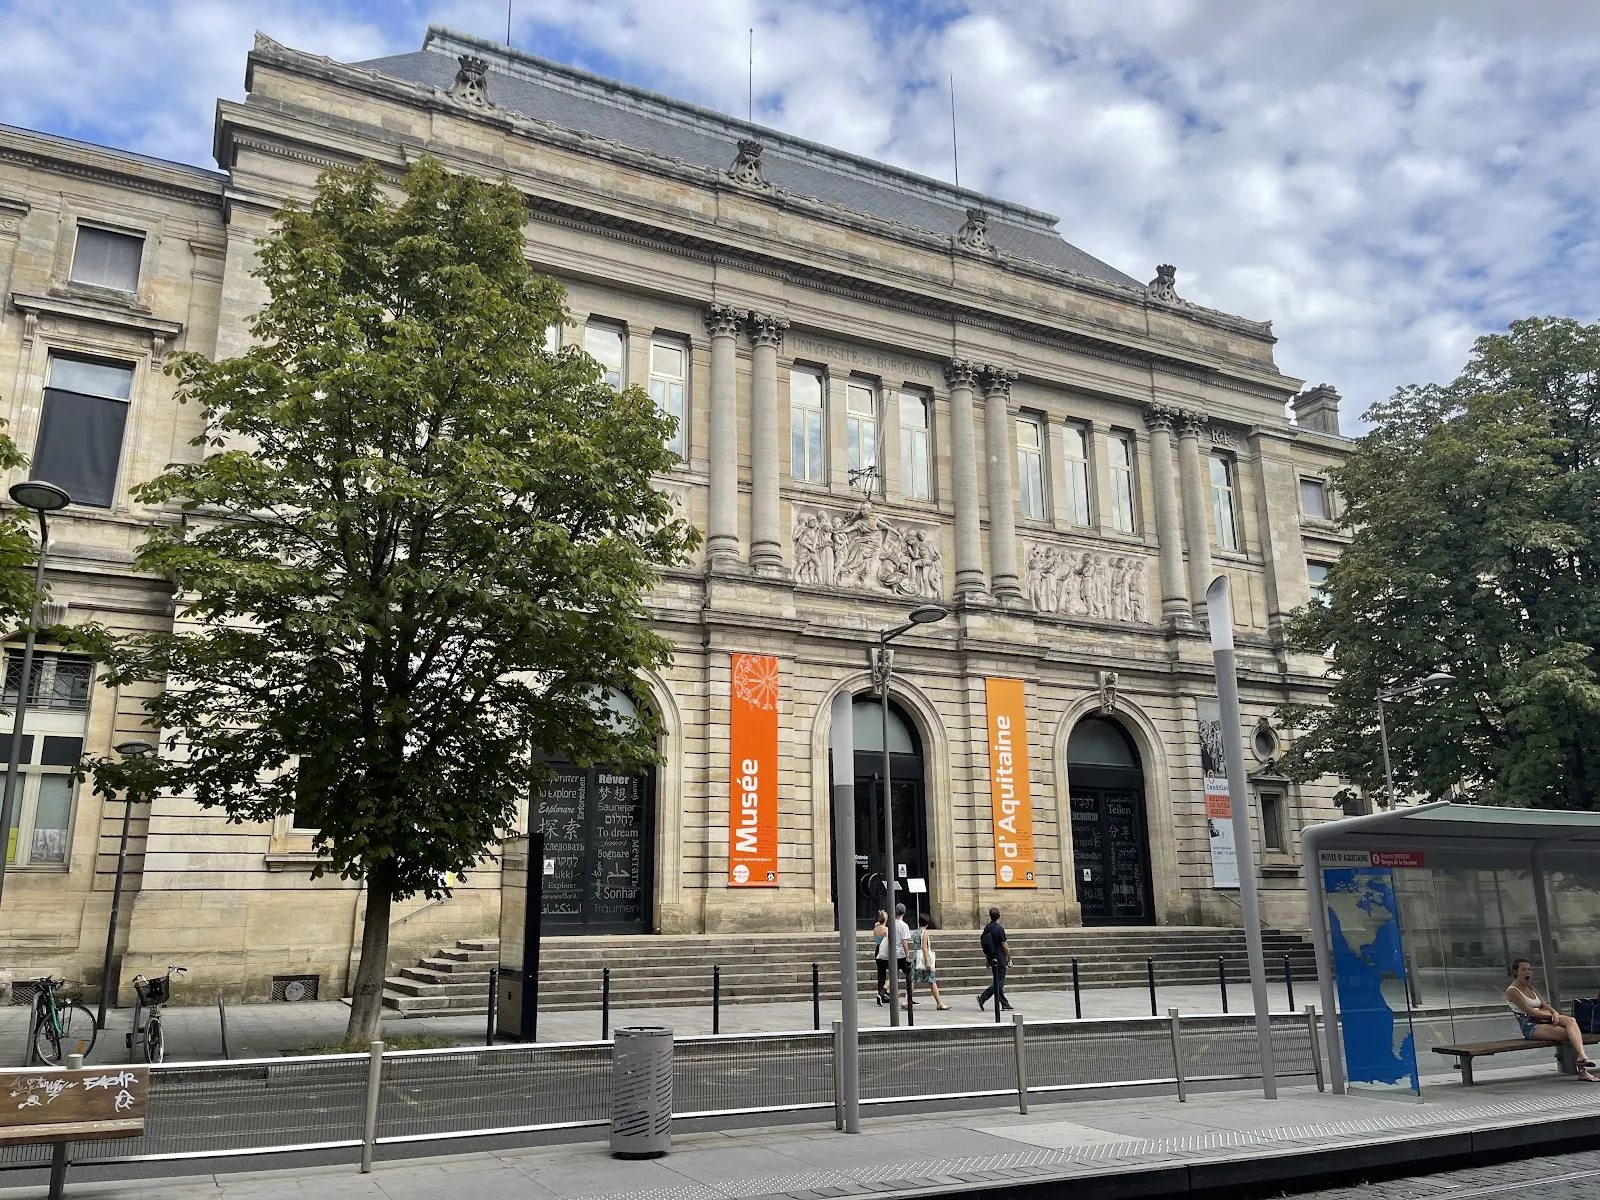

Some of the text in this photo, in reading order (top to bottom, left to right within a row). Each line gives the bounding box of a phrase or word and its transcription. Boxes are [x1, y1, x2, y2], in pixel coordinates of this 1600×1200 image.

[877, 357, 932, 380] BORDEAUX
[598, 774, 630, 785] Rêver
[994, 715, 1021, 858] d'Aquitaine
[735, 758, 759, 853] Musée
[1107, 804, 1131, 815] Teilen
[597, 827, 639, 838] To dream
[543, 842, 585, 852] следовать
[597, 849, 630, 860] Sognare
[548, 881, 577, 890] Explorer
[603, 886, 638, 900] Sonhar
